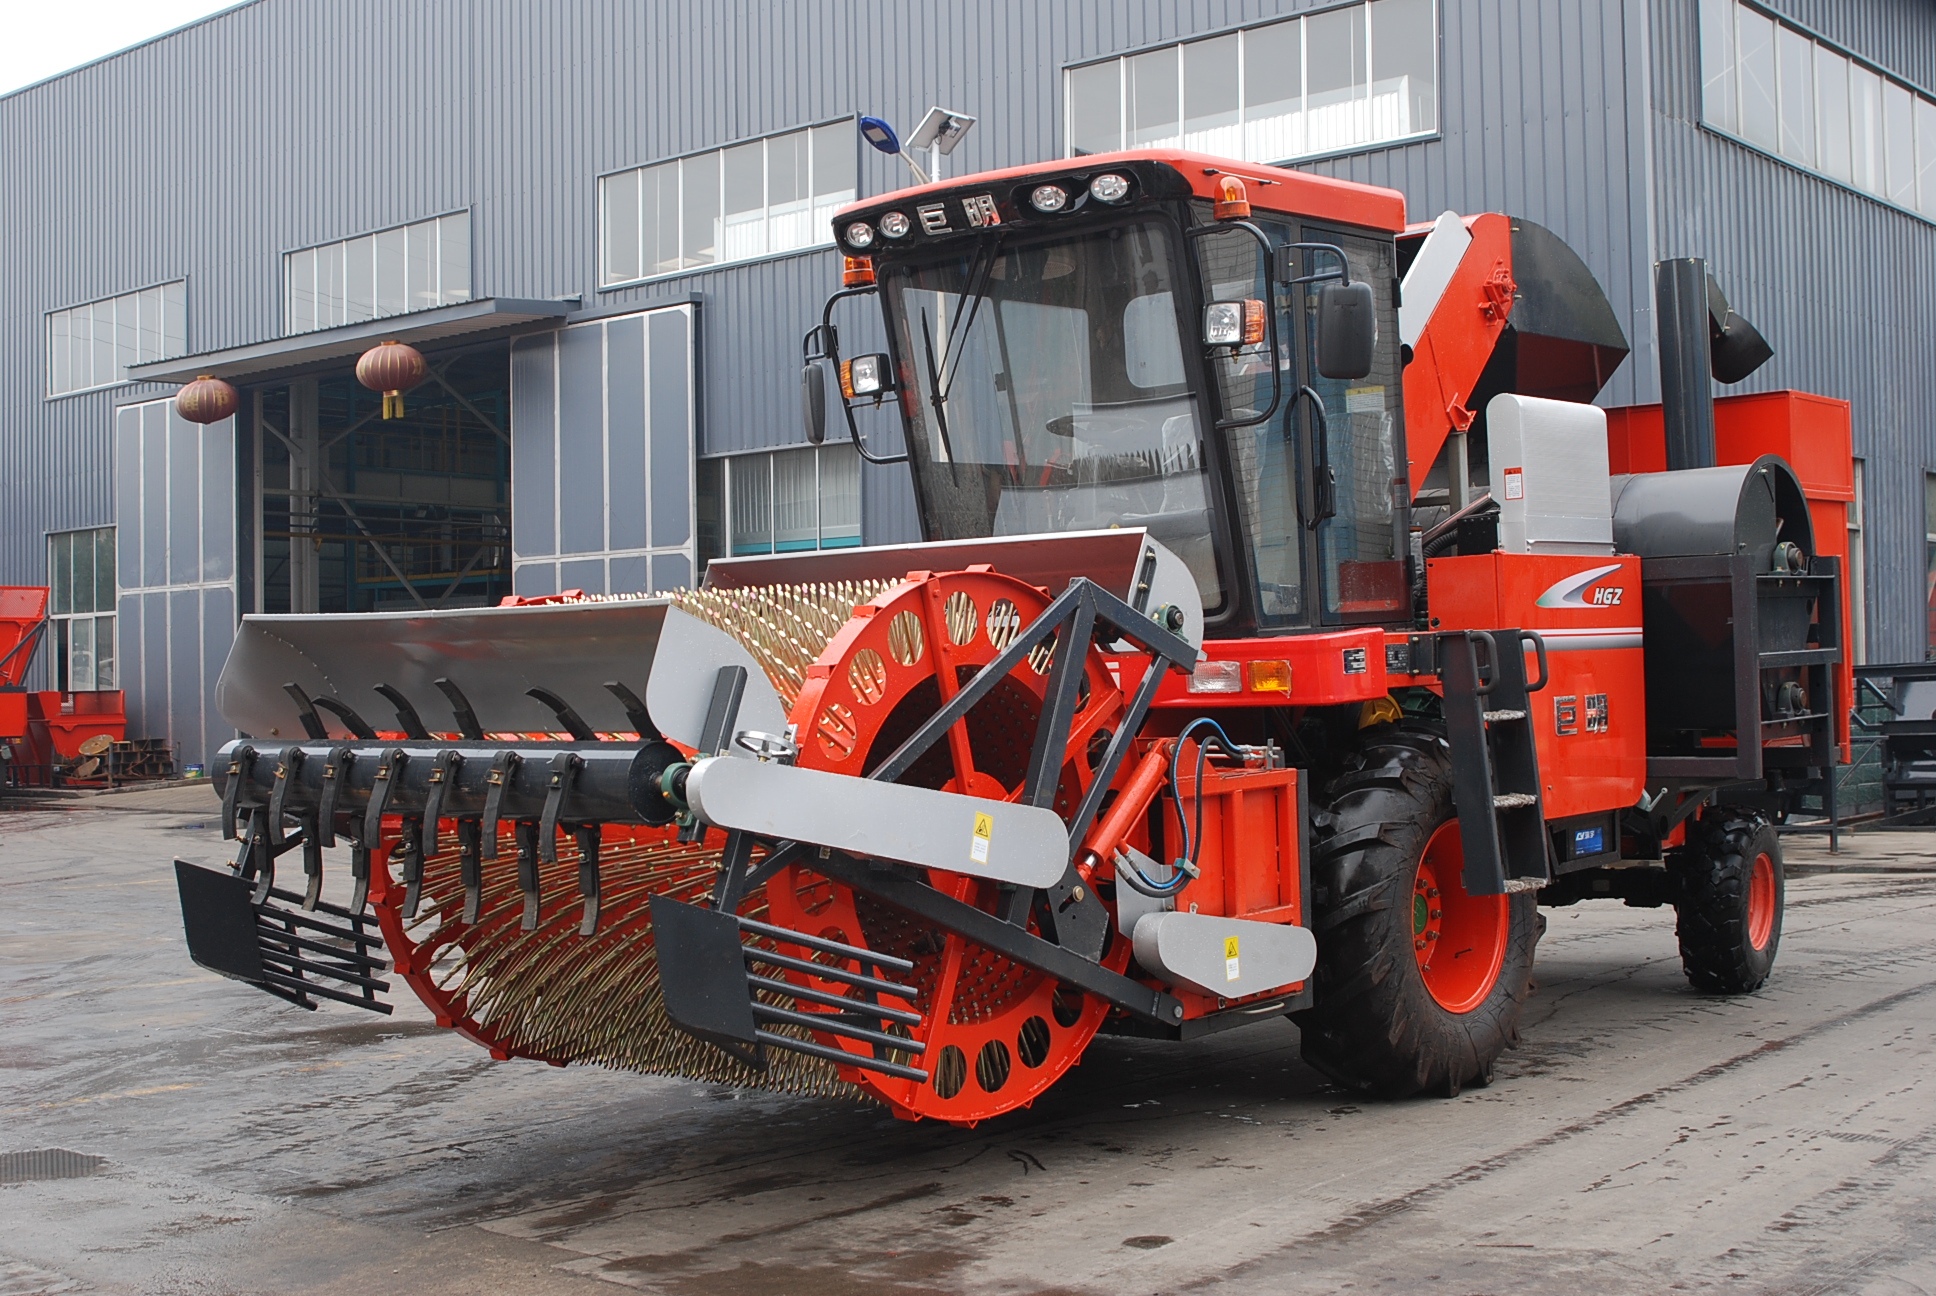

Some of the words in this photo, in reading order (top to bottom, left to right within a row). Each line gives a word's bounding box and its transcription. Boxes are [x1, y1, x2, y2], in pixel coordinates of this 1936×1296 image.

[916, 194, 1001, 236] 巨明
[1593, 586, 1624, 606] HGZ
[1553, 693, 1609, 737] 巨明
